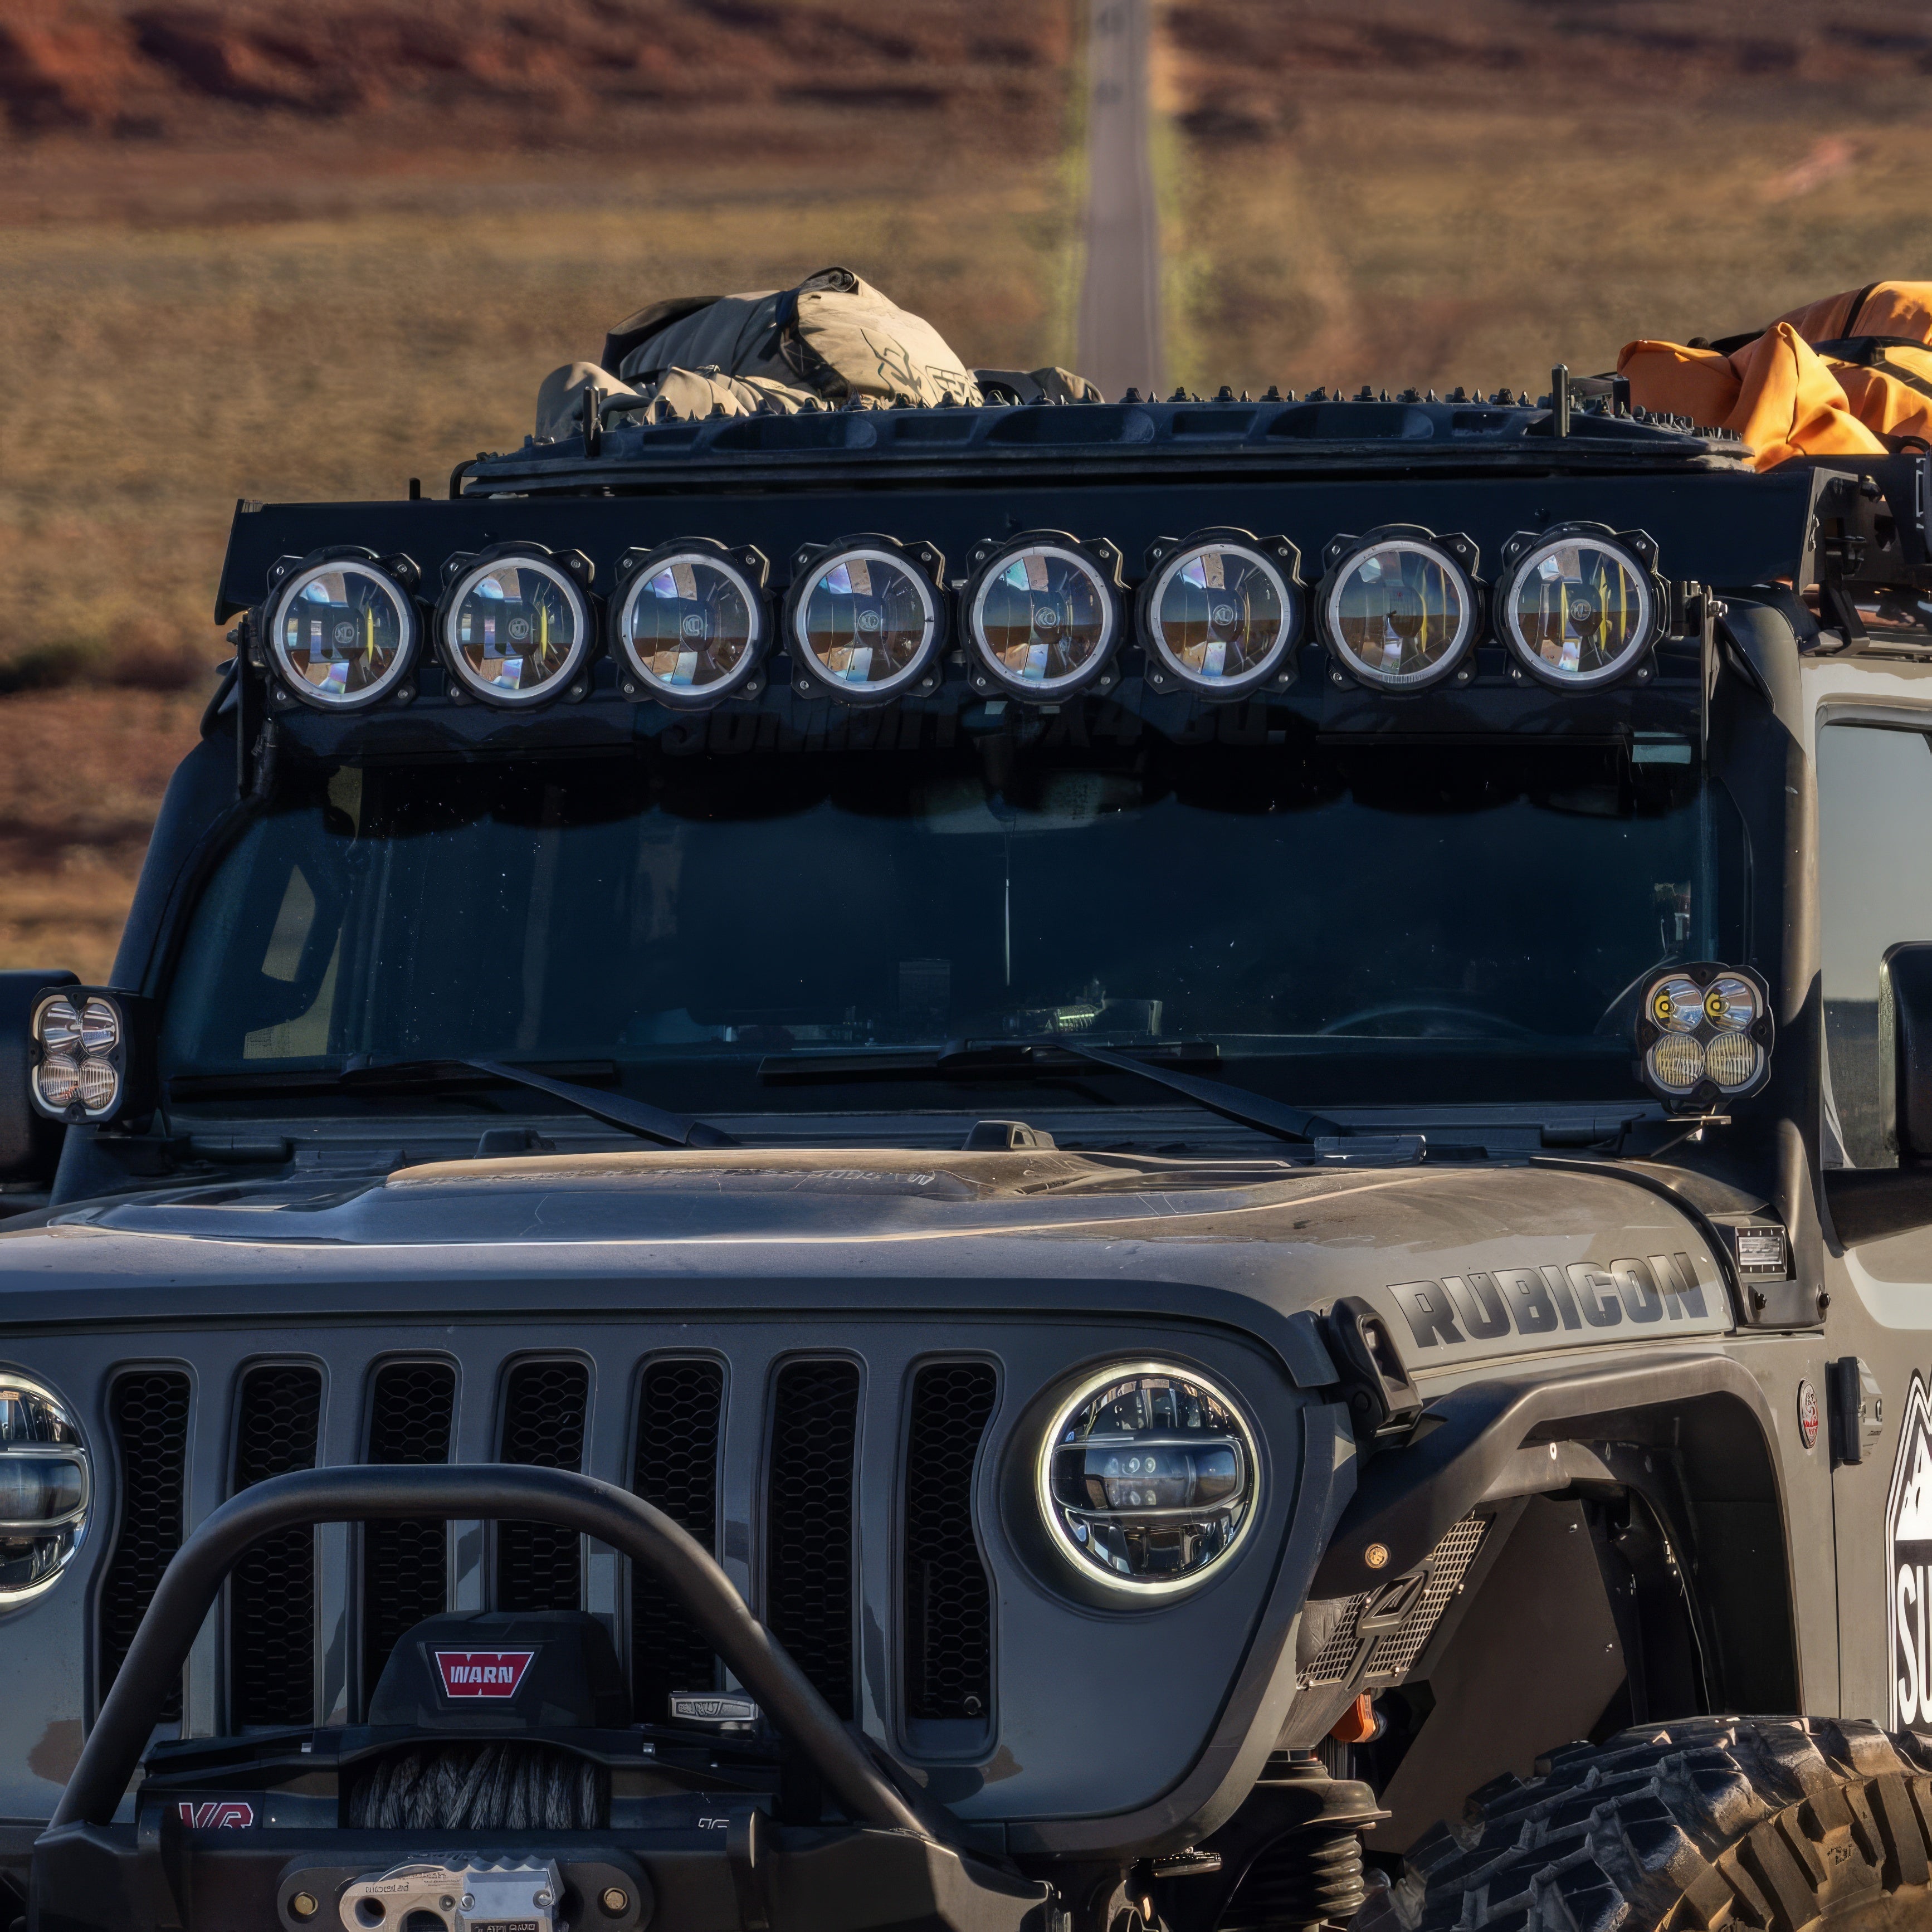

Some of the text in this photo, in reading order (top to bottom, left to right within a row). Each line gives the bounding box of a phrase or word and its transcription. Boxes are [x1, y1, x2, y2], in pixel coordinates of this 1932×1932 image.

[1385, 1252, 1709, 1348] RUBICON
[450, 1665, 514, 1684] WARN
[178, 1802, 253, 1829] VR
